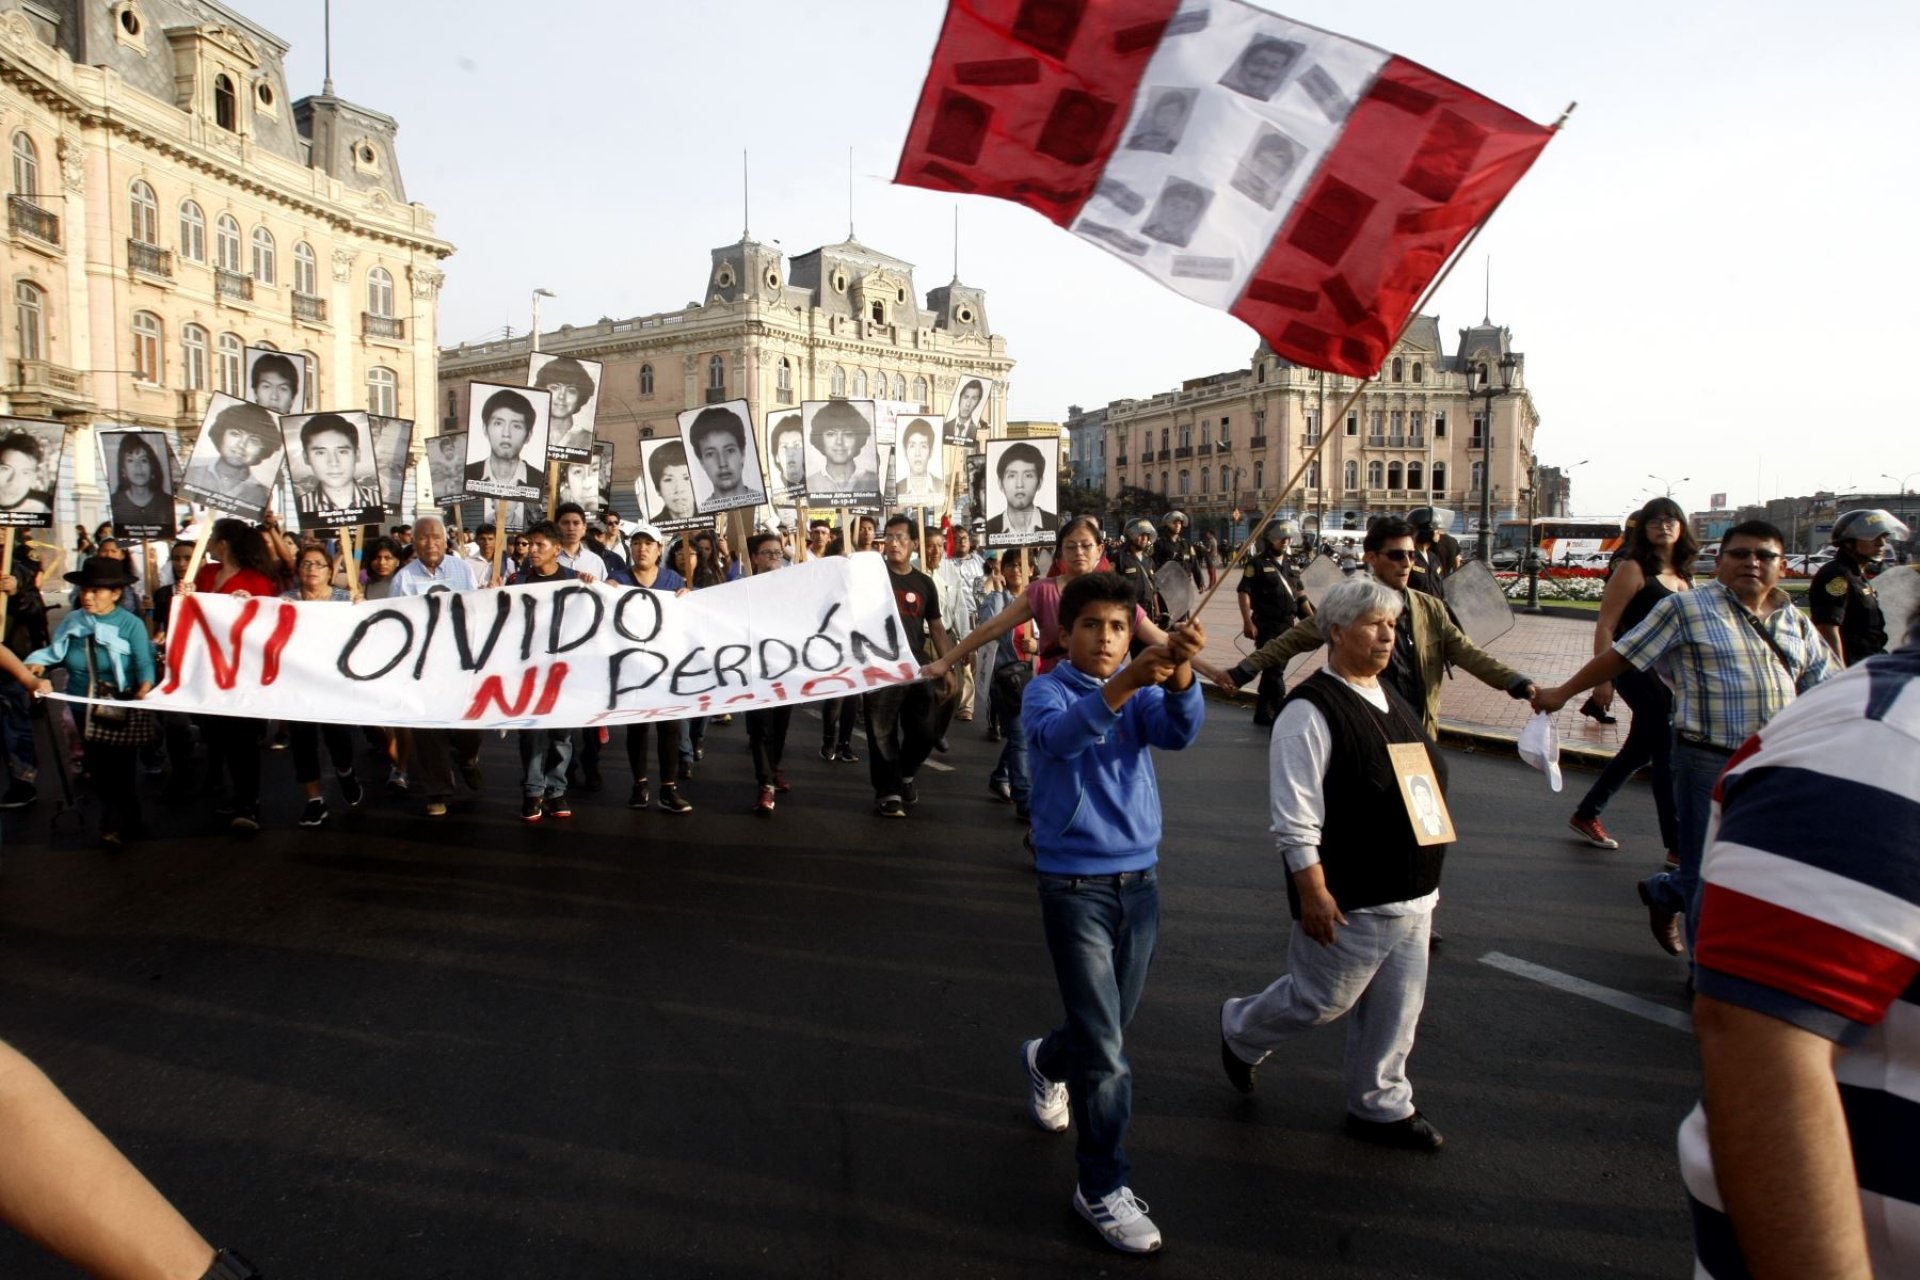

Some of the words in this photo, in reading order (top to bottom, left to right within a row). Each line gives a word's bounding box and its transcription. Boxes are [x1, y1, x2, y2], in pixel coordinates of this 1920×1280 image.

[163, 594, 296, 694] NI
[463, 661, 568, 720] NI
[608, 603, 900, 710] PERDÓN
